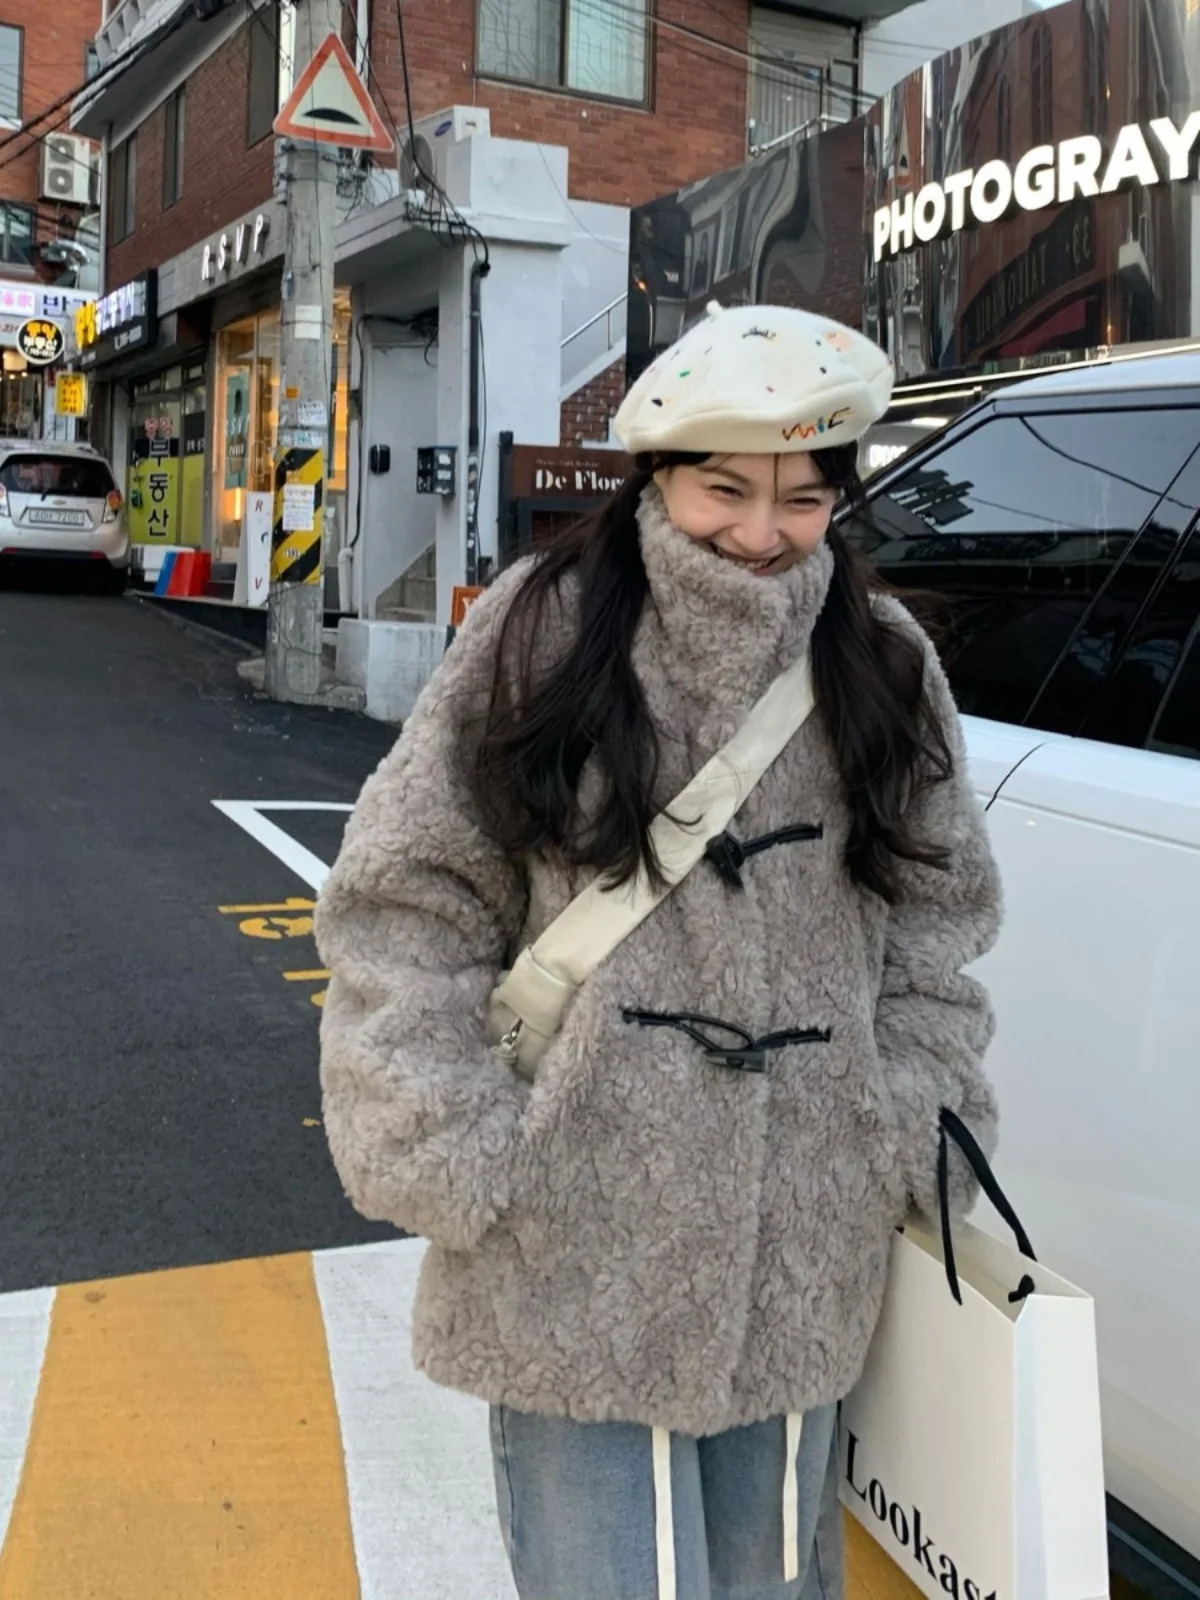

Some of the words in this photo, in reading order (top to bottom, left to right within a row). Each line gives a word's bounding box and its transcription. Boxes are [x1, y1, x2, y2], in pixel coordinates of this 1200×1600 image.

[873, 111, 1200, 263] PHOTOGRAY
[203, 213, 264, 281] RSVP
[148, 439, 169, 537] 부동산
[535, 469, 568, 490] De
